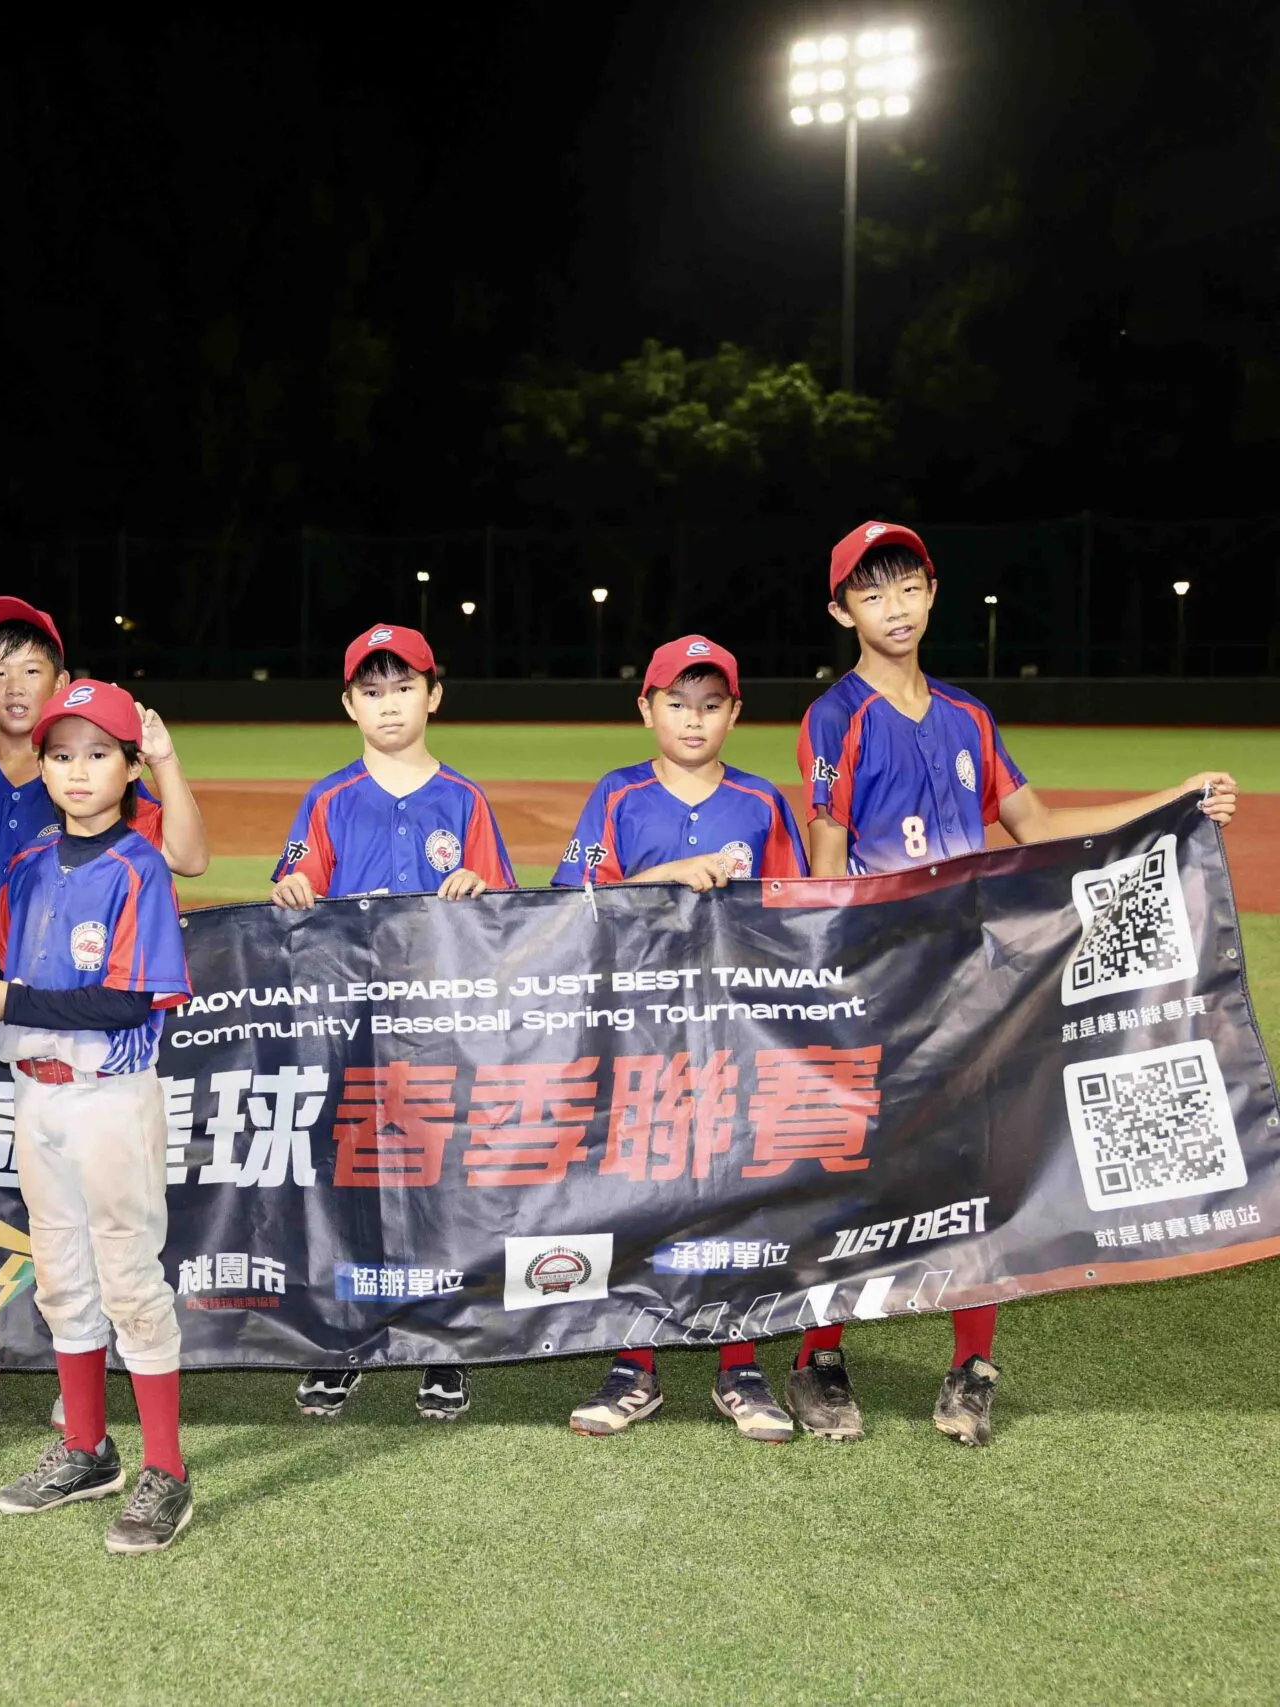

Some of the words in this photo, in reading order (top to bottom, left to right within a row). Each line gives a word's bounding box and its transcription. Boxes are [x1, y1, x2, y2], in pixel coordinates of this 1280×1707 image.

[368, 629, 392, 646] S
[64, 686, 95, 707] S
[283, 840, 310, 864] 市
[562, 839, 608, 869] 北市
[902, 816, 927, 857] 8
[175, 984, 318, 1018] TAOYUAN
[328, 977, 498, 1002] LEOPARDS
[509, 973, 602, 997] JUST
[612, 969, 701, 992] BEST
[711, 966, 843, 989] TAIWAN
[171, 1016, 361, 1049] Community
[371, 1009, 511, 1035] Baseball
[522, 1006, 634, 1035] Spring
[647, 996, 866, 1025] Tournament
[1061, 995, 1207, 1043] 就是棒粉絲專頁
[818, 1217, 910, 1262] JUST
[906, 1196, 990, 1244] BEST
[1094, 1204, 1261, 1248] 就是棒賽事網站
[177, 1252, 286, 1295] 桃園市
[670, 1241, 791, 1270] 承辦單位
[352, 1266, 465, 1298] 協辦單位
